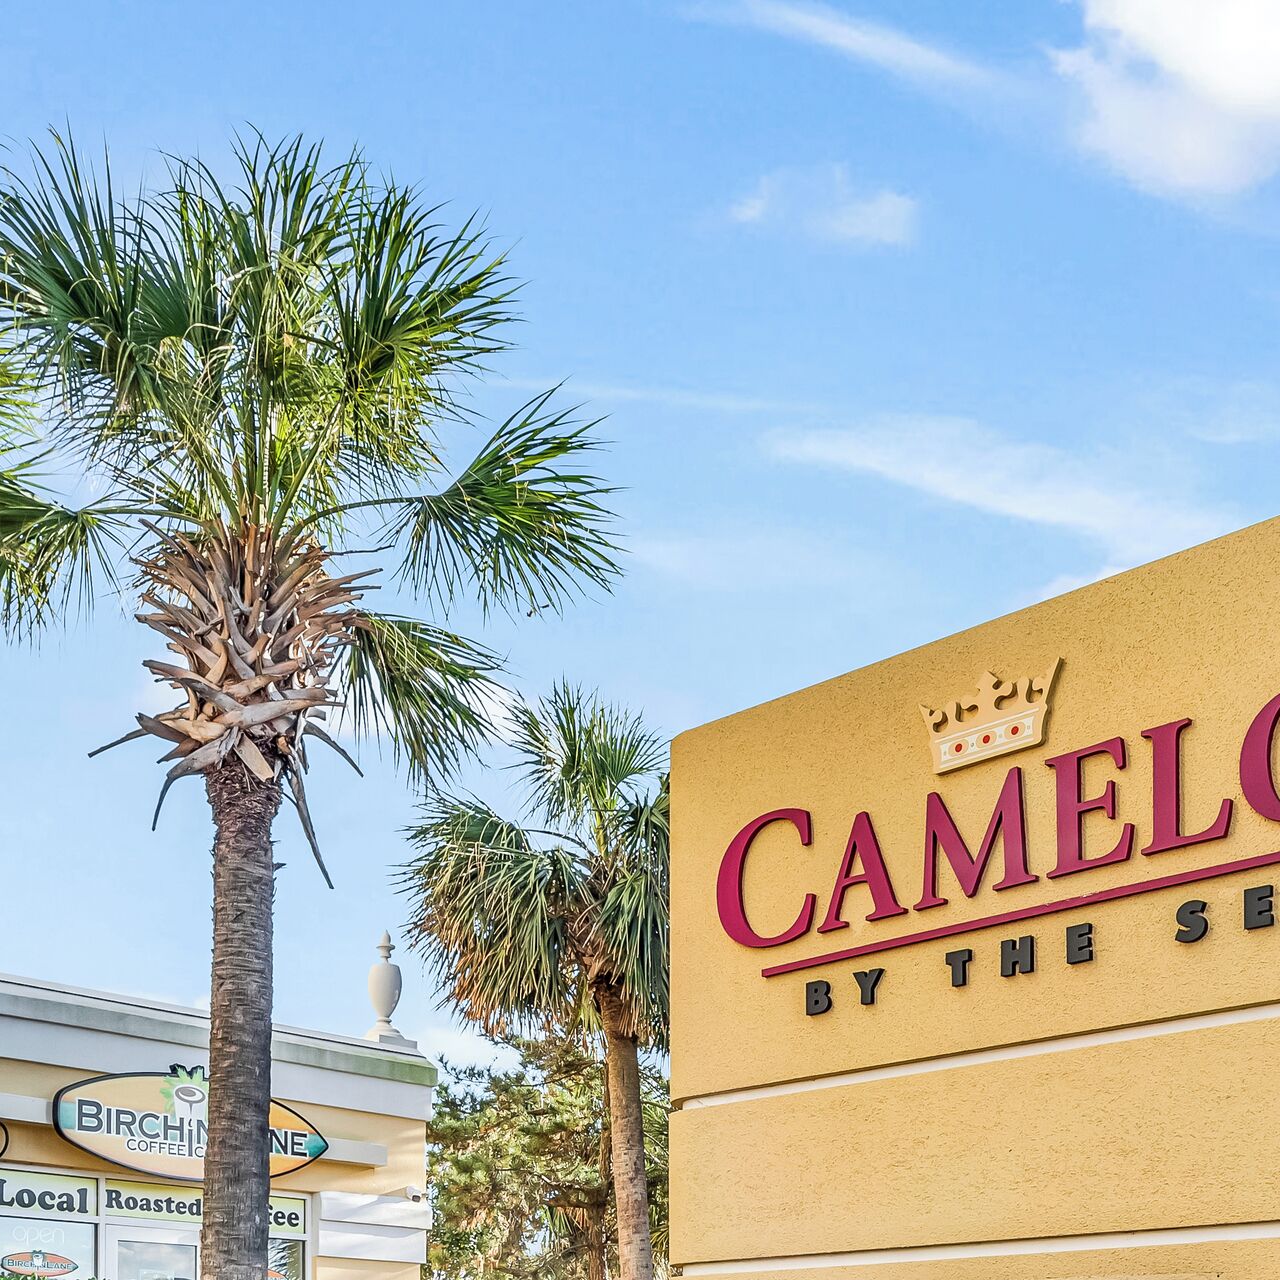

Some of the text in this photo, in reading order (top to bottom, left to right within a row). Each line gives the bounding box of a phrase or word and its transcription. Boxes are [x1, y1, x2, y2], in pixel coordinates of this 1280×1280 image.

[805, 968, 886, 1017] BY
[945, 922, 1094, 988] THE
[126, 1138, 186, 1157] COFFEE
[105, 1188, 202, 1217] Roasted
[12, 1225, 65, 1248] open
